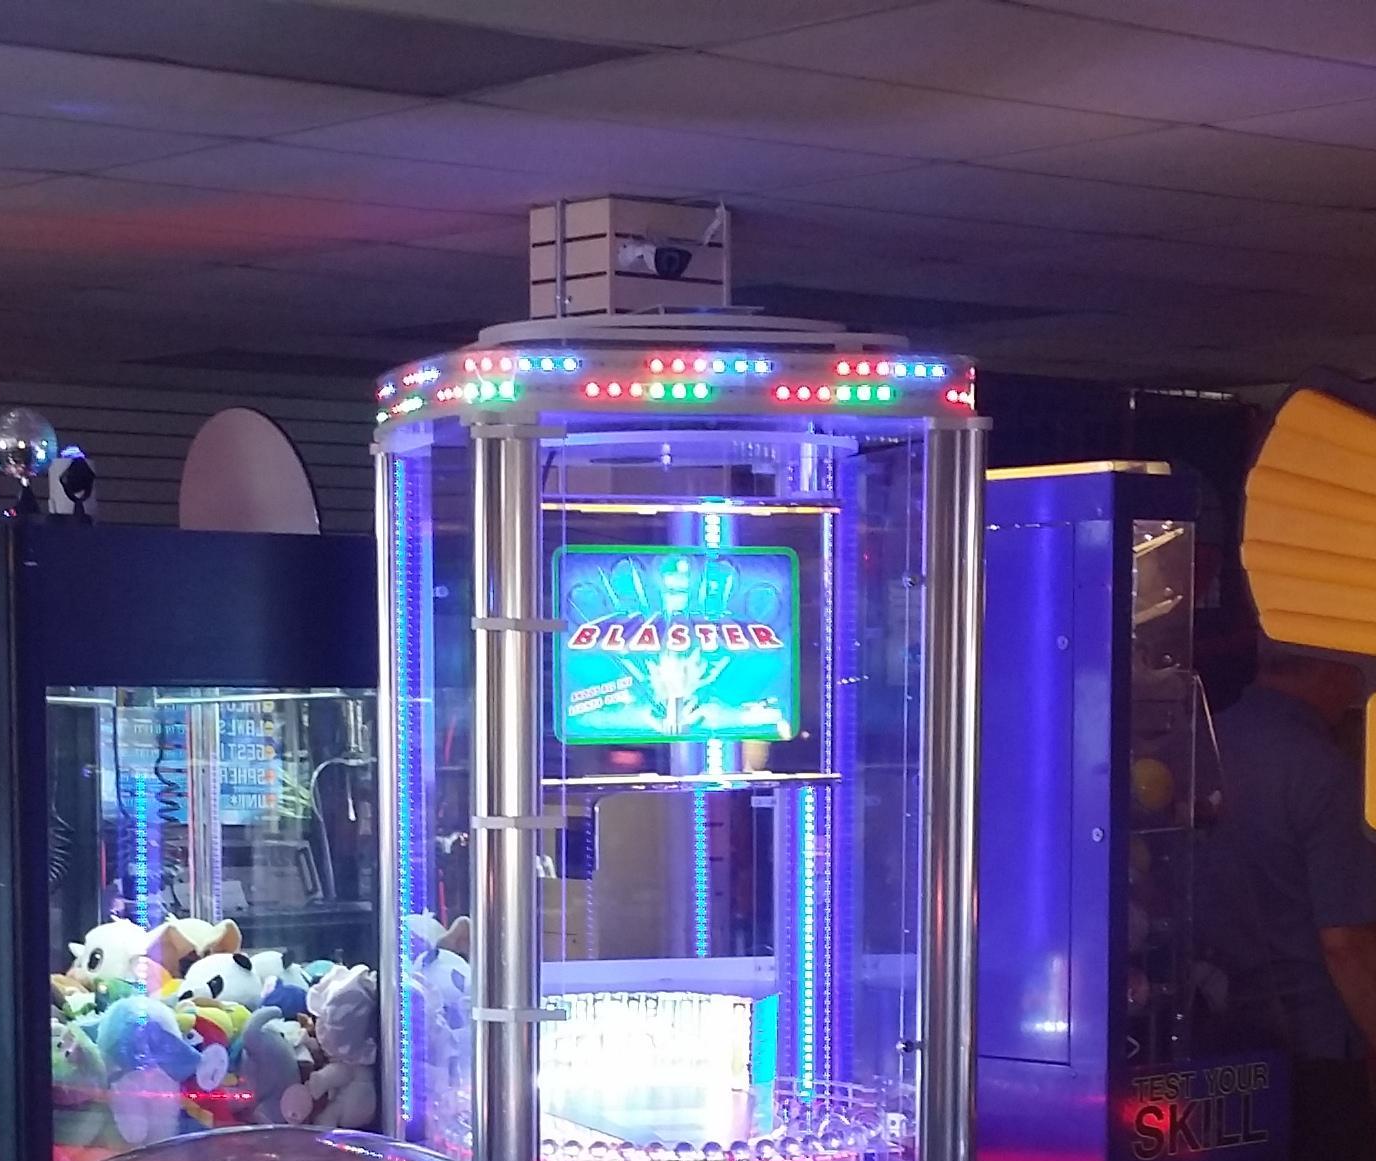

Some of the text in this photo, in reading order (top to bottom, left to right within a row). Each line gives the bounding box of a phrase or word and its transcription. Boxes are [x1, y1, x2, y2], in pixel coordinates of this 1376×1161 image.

[567, 623, 784, 652] BLASTER
[1132, 1062, 1270, 1103] TEST YOUR
[1132, 1092, 1270, 1161] SKILL
